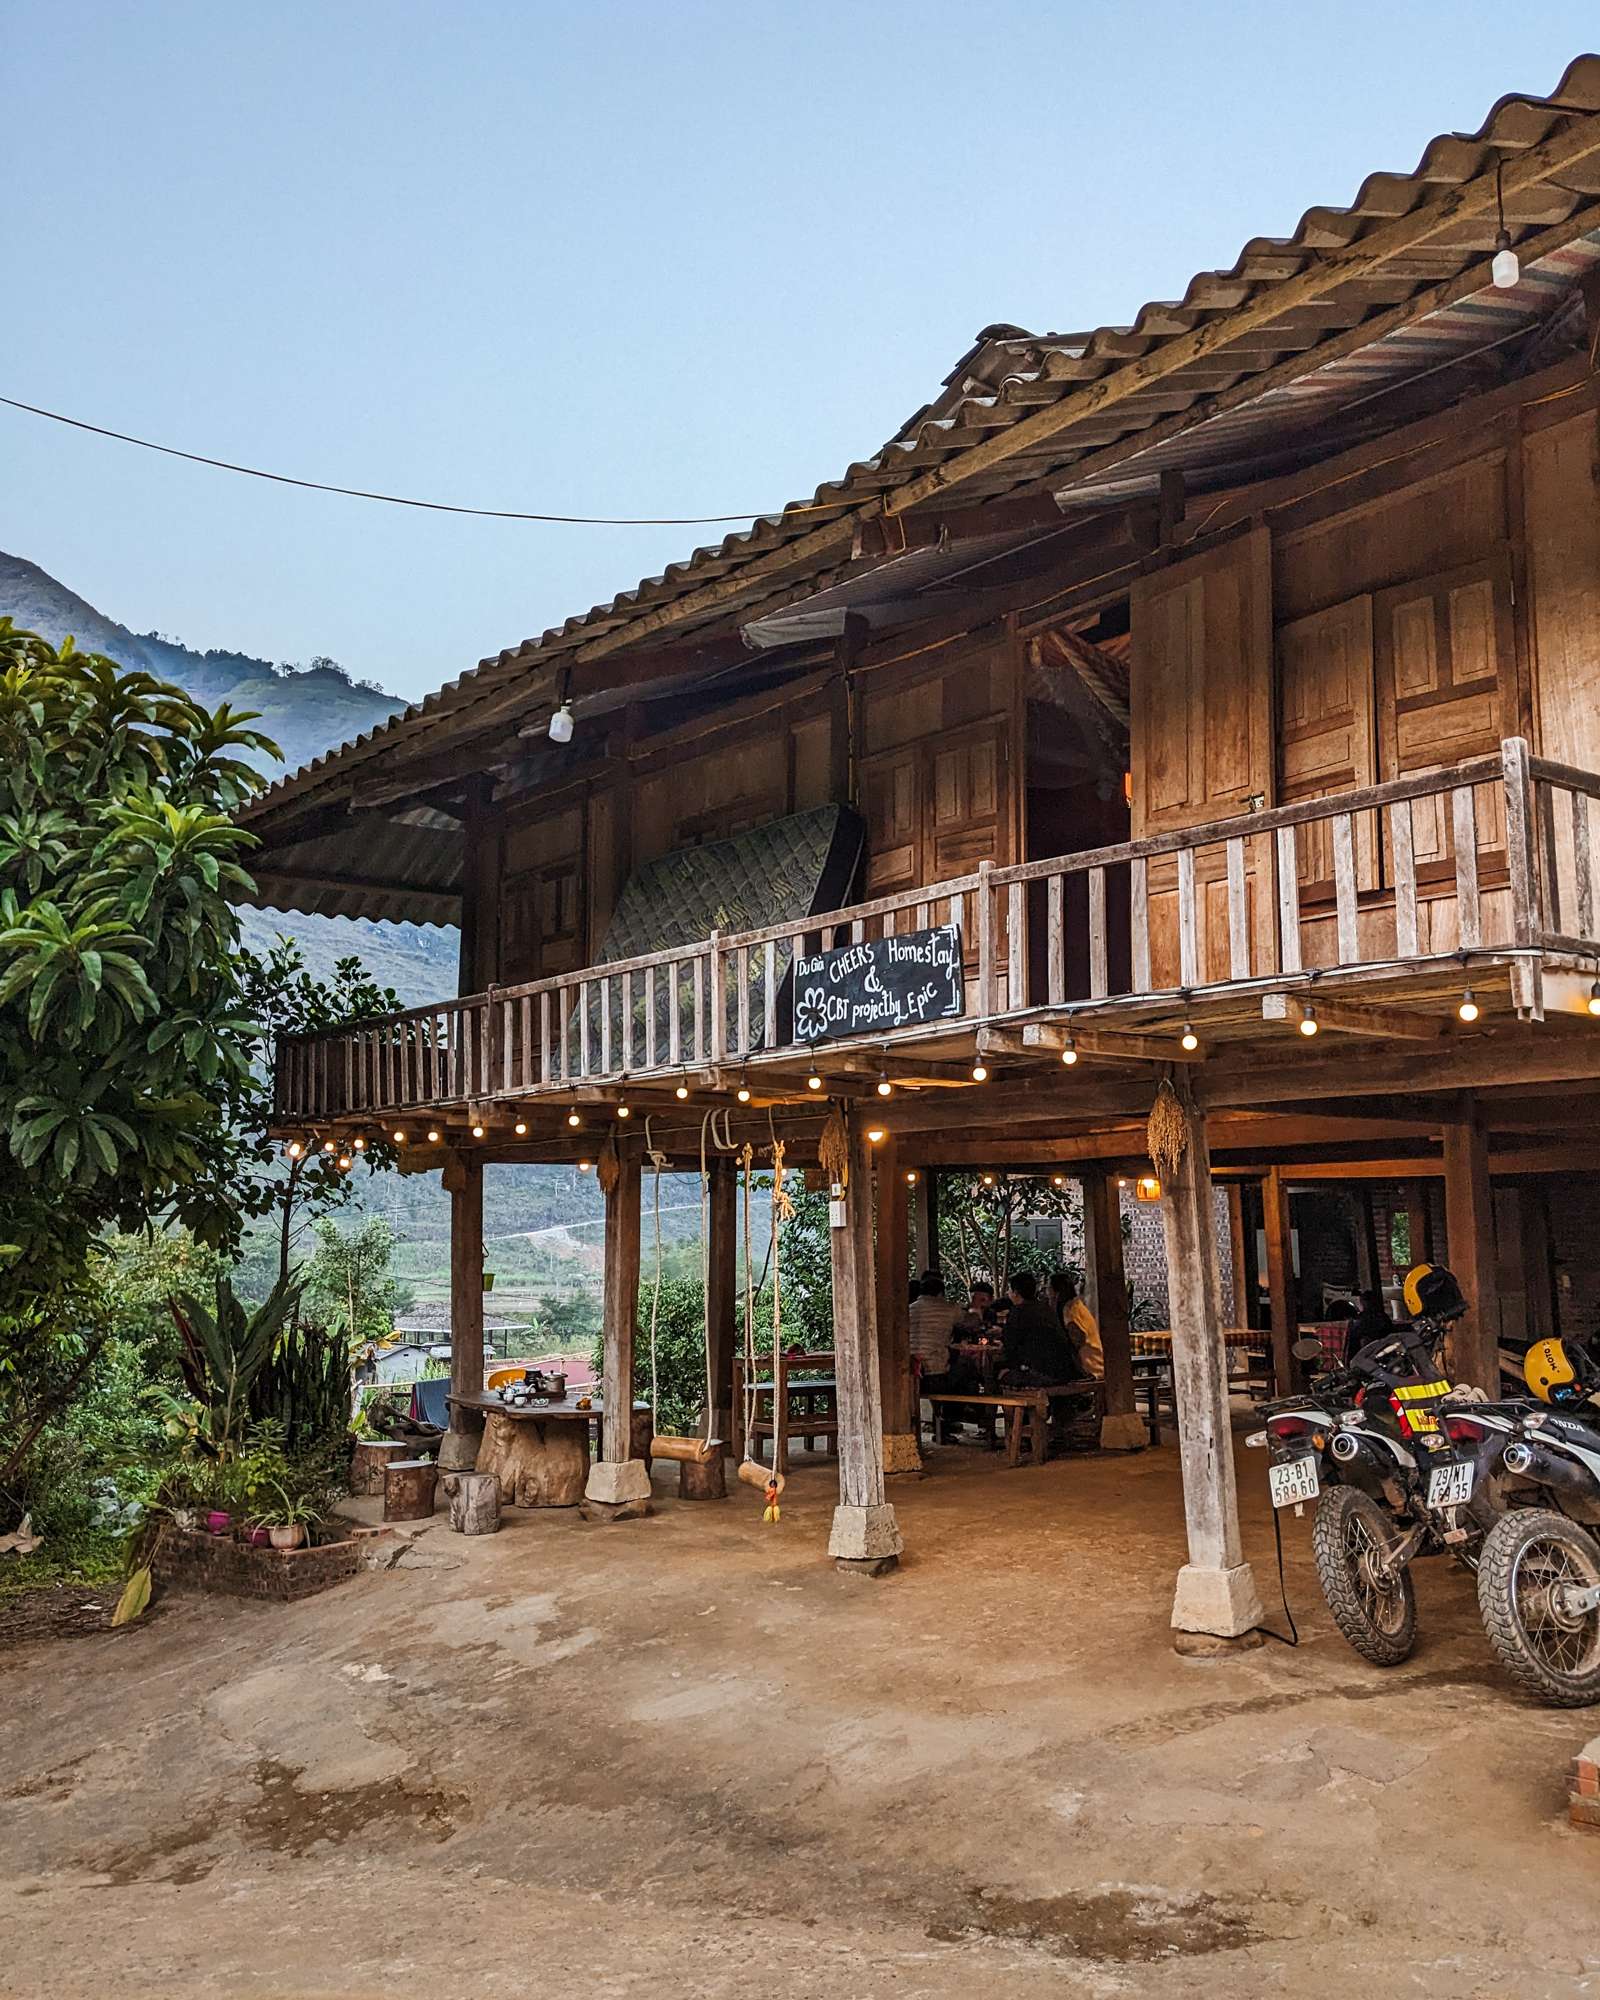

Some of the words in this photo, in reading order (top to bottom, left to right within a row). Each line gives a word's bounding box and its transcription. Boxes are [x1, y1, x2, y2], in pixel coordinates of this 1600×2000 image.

[829, 942, 875, 983] CHEERS
[888, 933, 960, 980] Homestay
[864, 965, 884, 993] &
[827, 995, 850, 1021] CBT
[907, 981, 938, 1019] Epic
[1277, 1461, 1309, 1486] 23-B1
